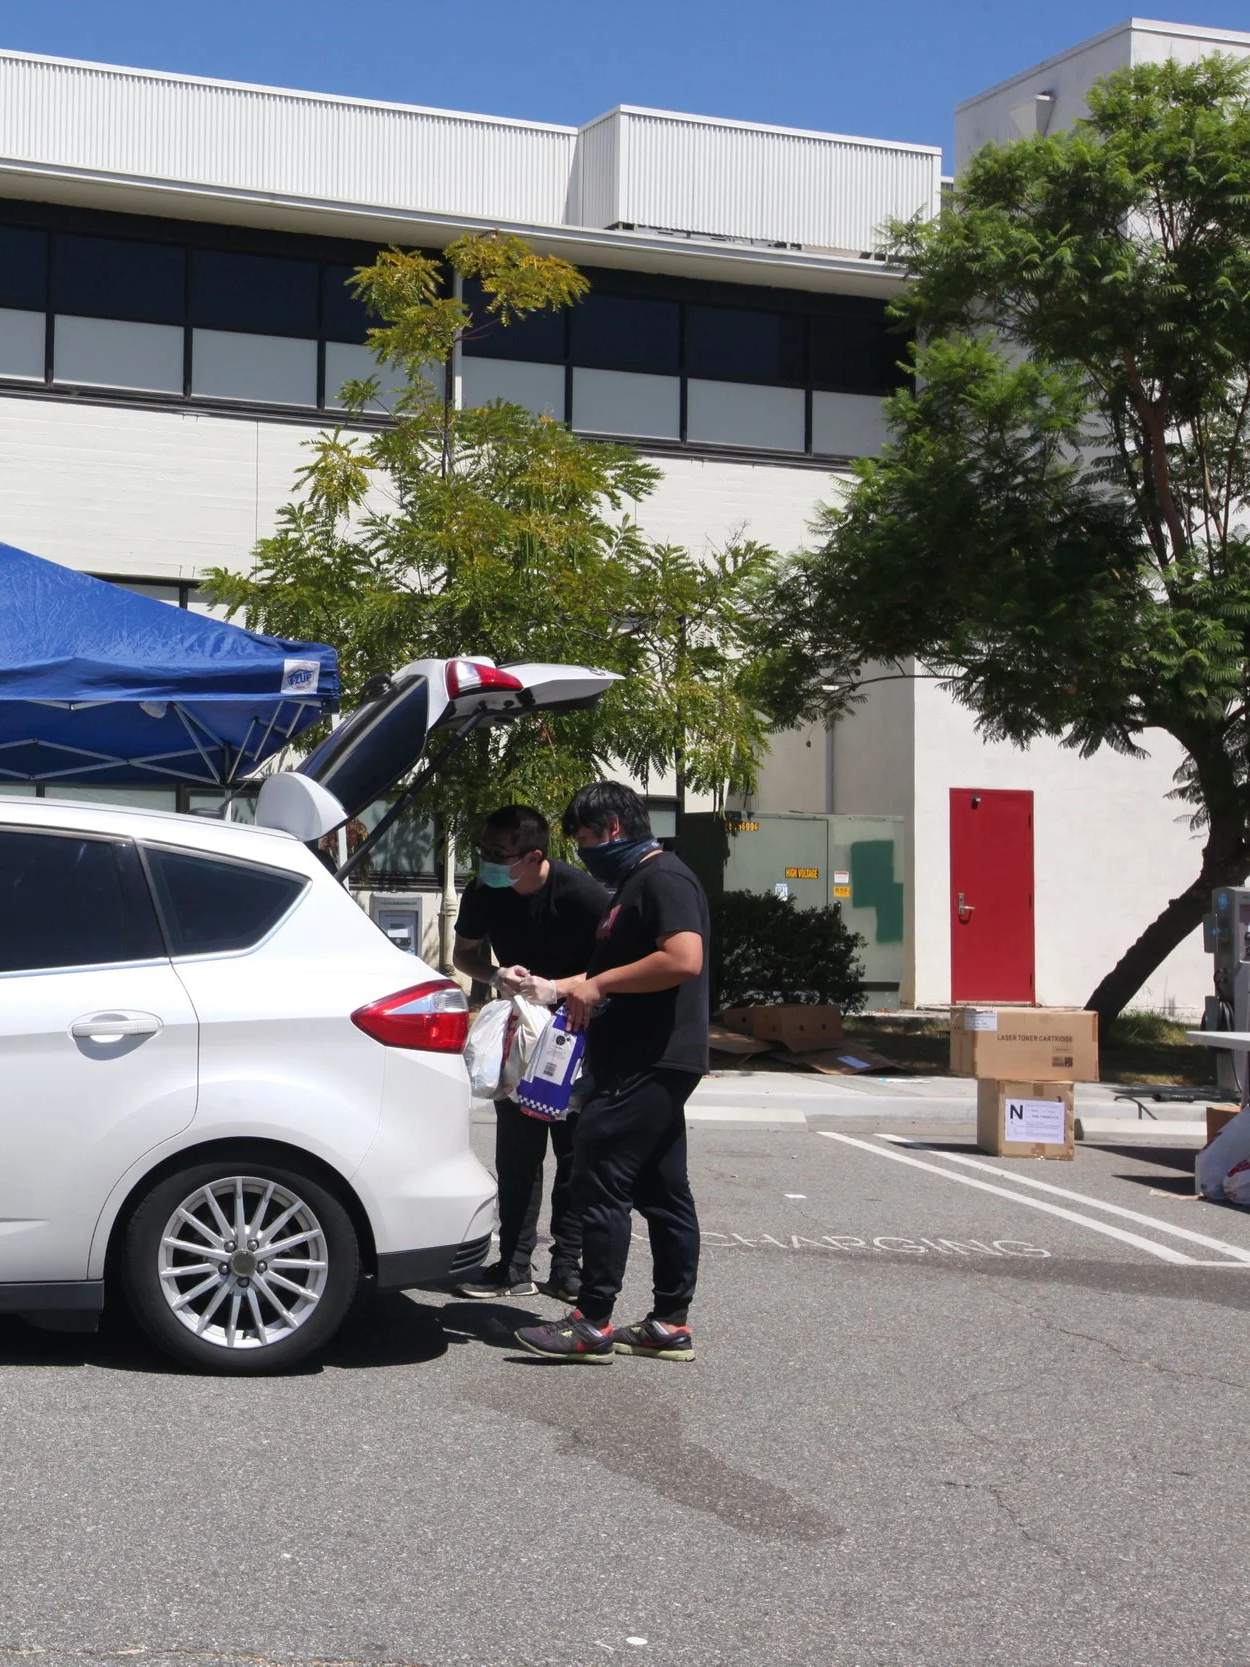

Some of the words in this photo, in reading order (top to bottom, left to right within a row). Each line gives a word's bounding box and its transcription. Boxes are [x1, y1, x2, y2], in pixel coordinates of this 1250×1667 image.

[786, 868, 797, 878] HIGH
[798, 868, 818, 879] VOLTAGE
[997, 1034, 1017, 1042] LASER
[1018, 1034, 1038, 1042] TONER
[1038, 1035, 1073, 1043] CARTRIDGE
[1010, 1104, 1023, 1120] N
[698, 1231, 1052, 1258] CHARGING
